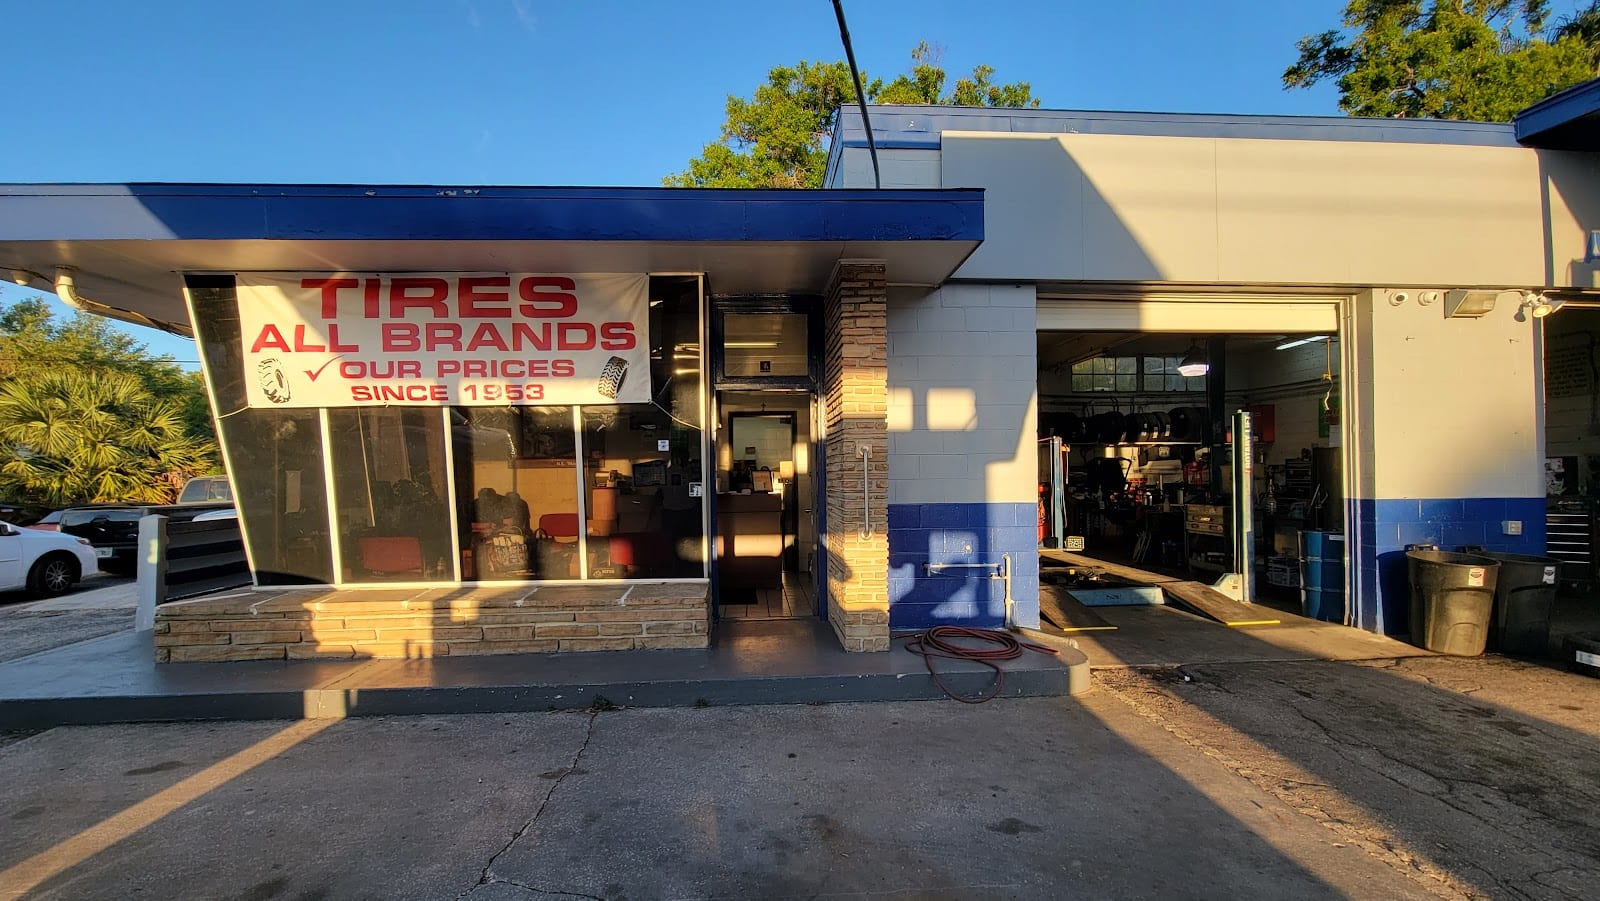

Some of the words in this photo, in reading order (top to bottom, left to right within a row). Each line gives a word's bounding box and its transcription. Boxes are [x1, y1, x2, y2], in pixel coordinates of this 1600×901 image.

[300, 276, 579, 319] TIRES
[251, 323, 360, 353] ALL
[382, 322, 637, 352] BRANDS
[339, 360, 422, 379] OUR
[438, 359, 576, 378] PRICES
[351, 385, 449, 402] SINCE
[464, 384, 545, 401] 1953
